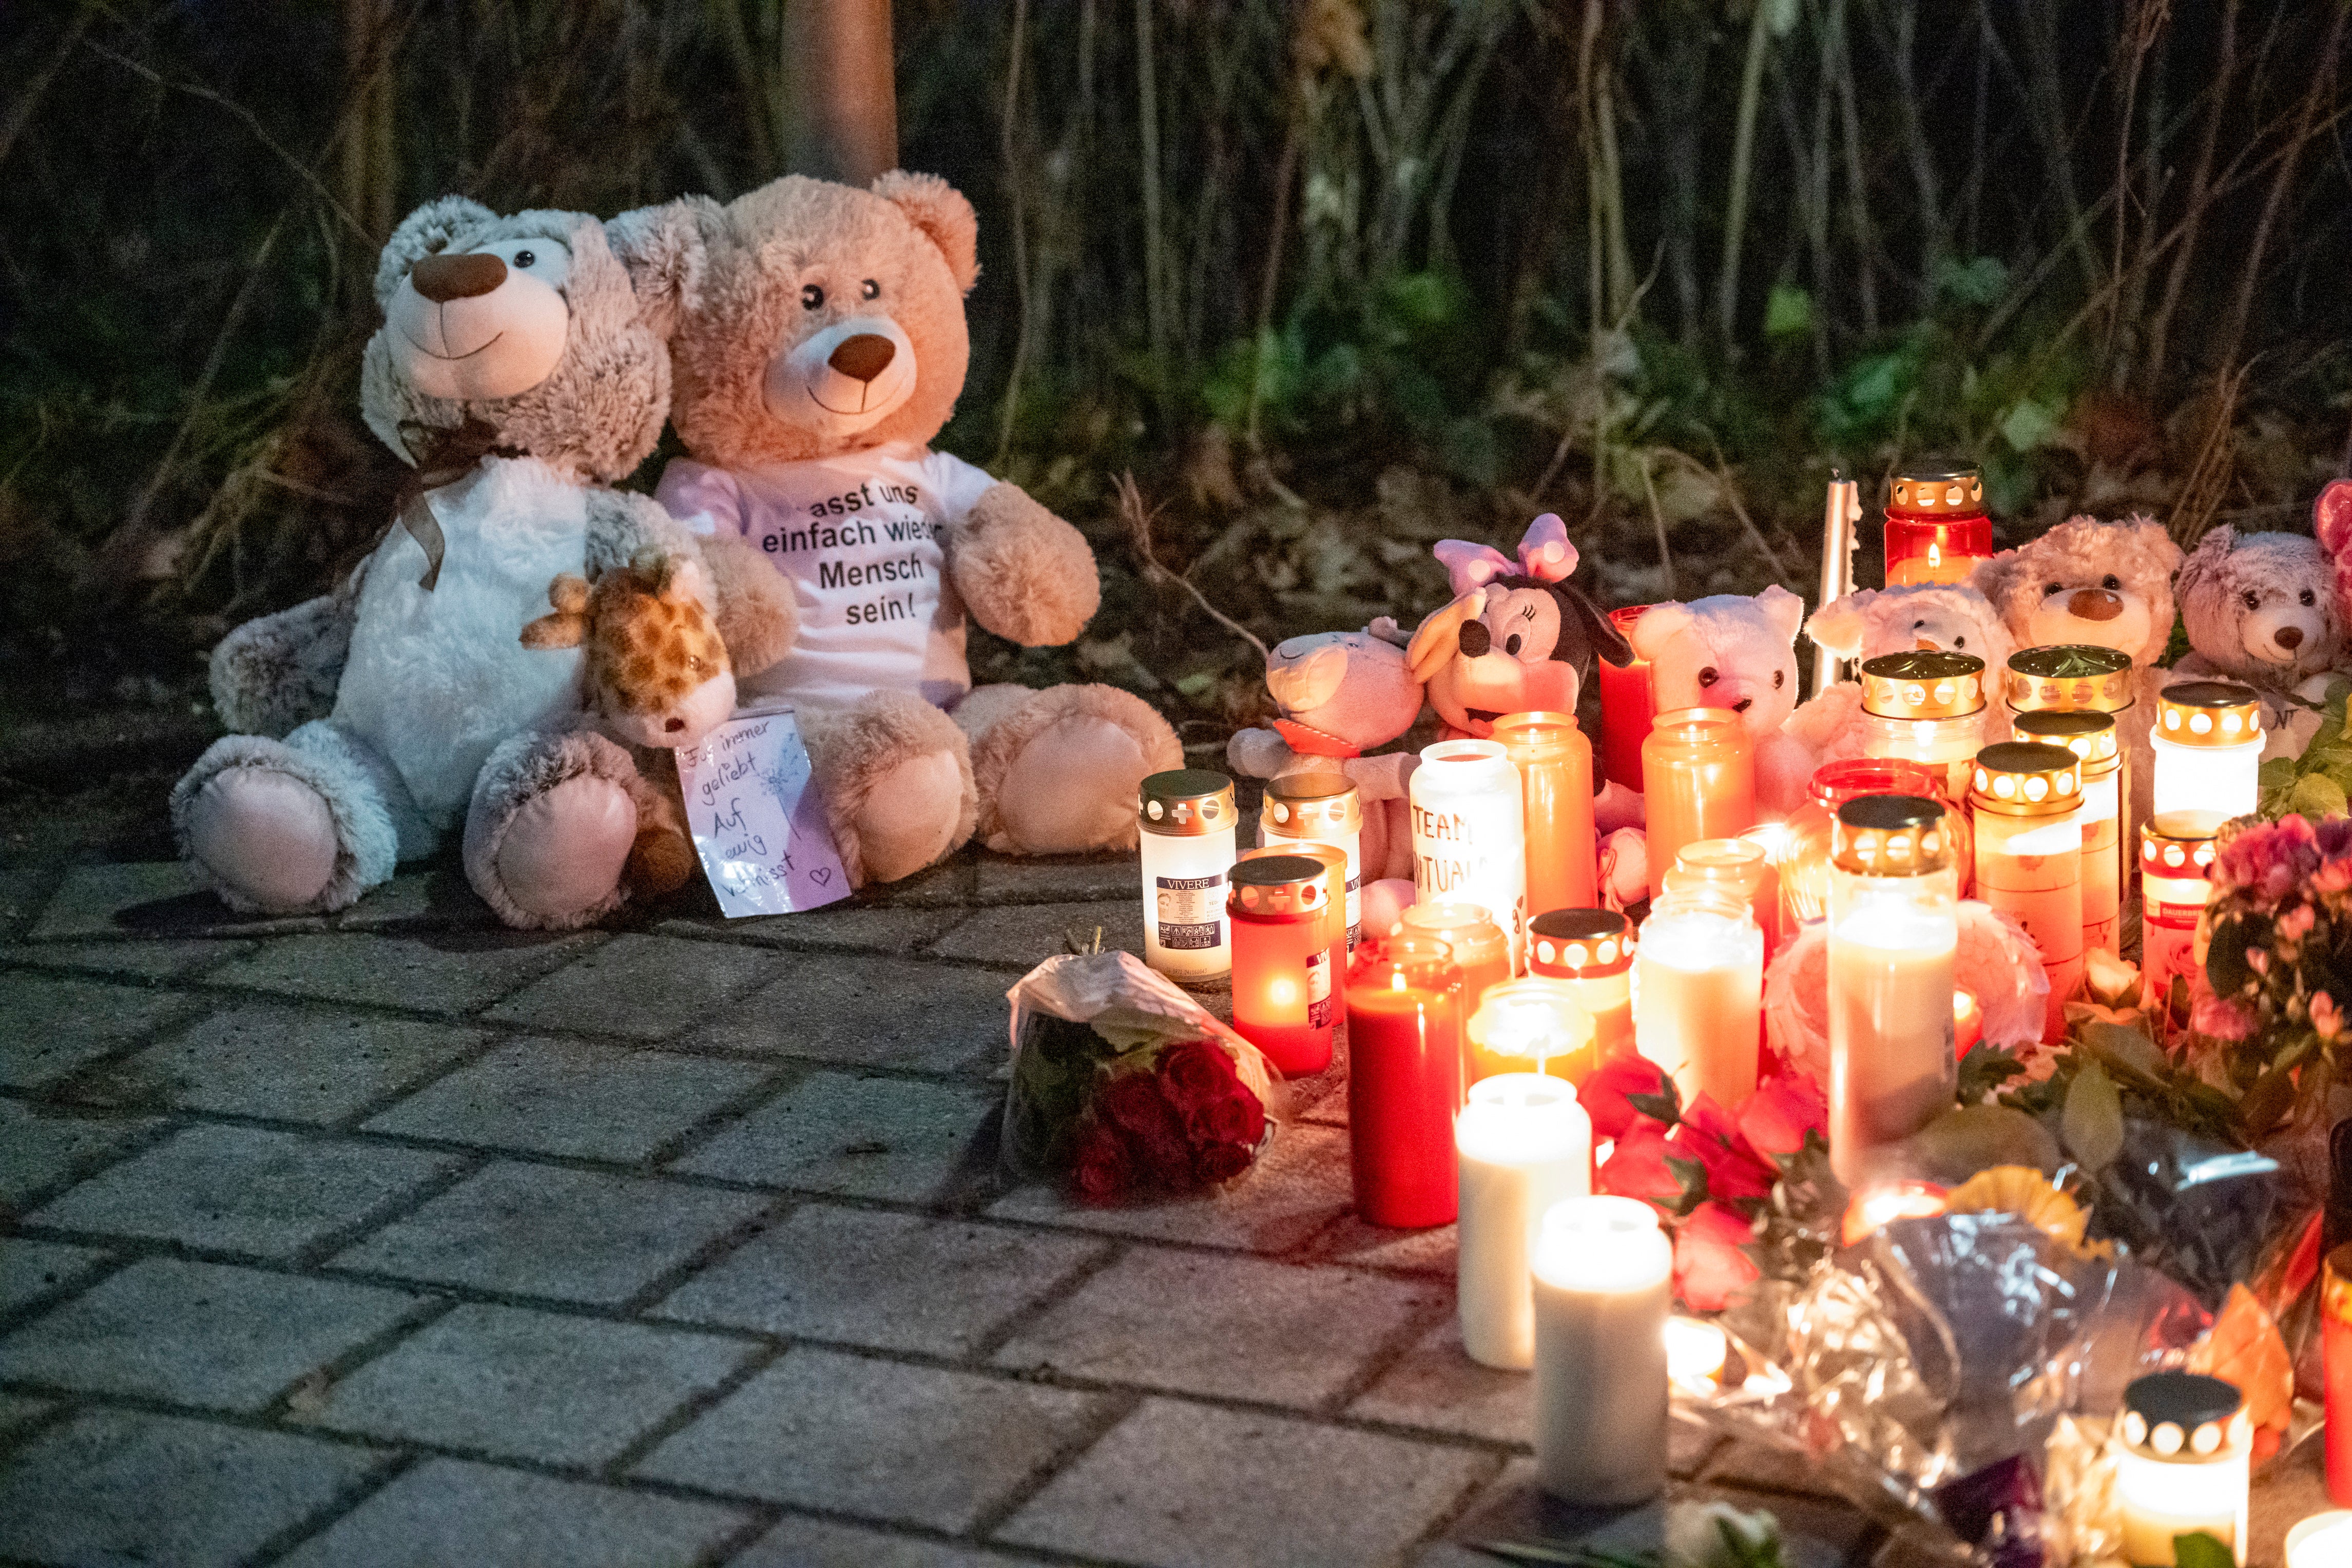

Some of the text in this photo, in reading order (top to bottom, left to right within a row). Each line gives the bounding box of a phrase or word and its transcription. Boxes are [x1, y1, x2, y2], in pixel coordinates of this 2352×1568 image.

[809, 483, 918, 517] asst uns
[762, 520, 876, 553] einfach
[819, 552, 924, 590] Mensch
[846, 592, 916, 625] sein!
[721, 721, 769, 751] immer
[702, 751, 756, 806] geliebt
[714, 797, 747, 839] Auf
[1413, 805, 1473, 845] TEAM
[725, 833, 767, 859] ewig
[722, 849, 795, 897] vmisst
[1167, 878, 1209, 889] VIVERE
